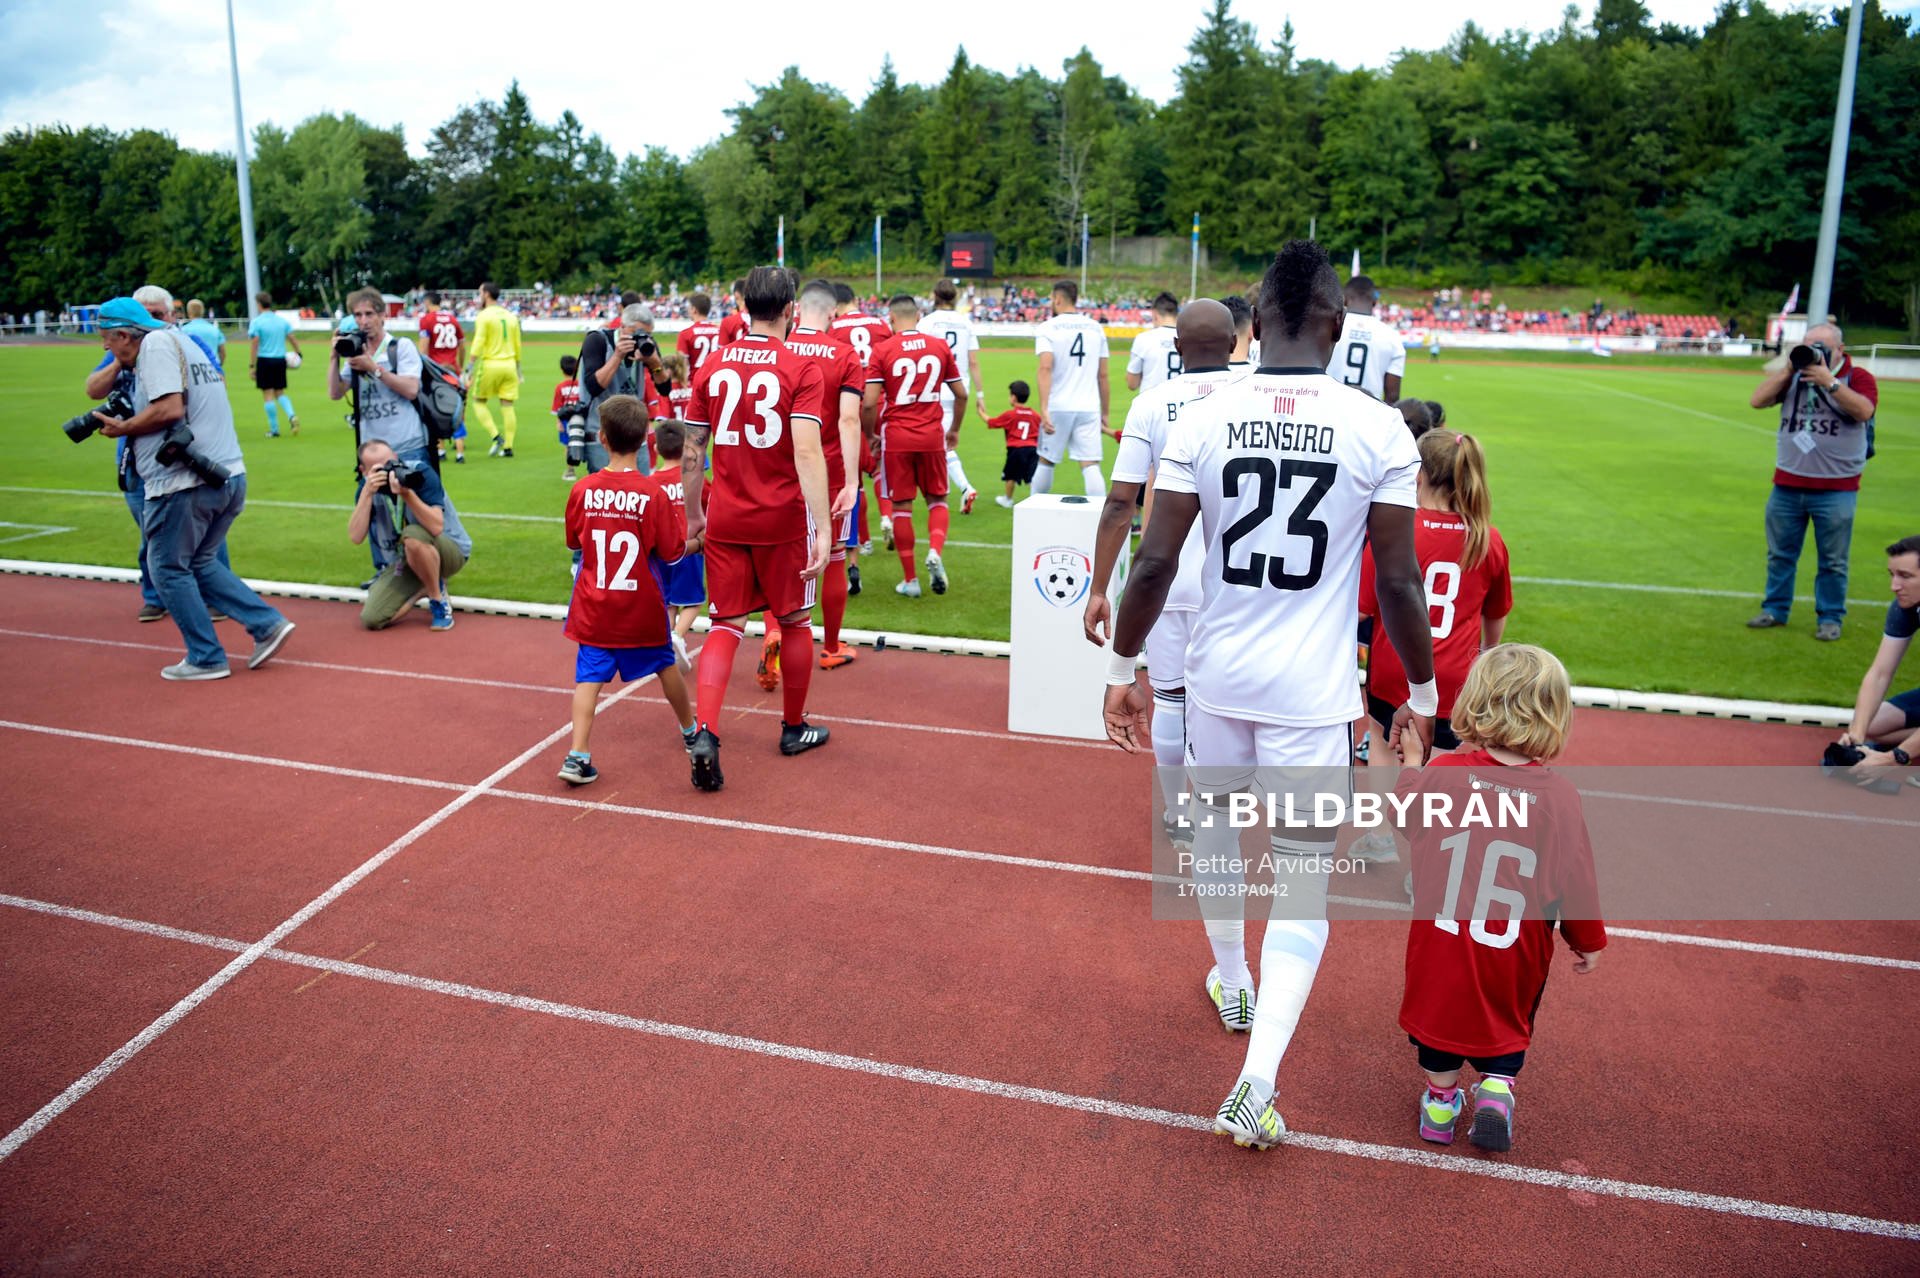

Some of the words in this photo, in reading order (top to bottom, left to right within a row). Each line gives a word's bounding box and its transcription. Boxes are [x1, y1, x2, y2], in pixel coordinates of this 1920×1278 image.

[433, 323, 458, 349] 28
[784, 342, 836, 359] ETKOVIC
[850, 327, 872, 367] 8
[901, 338, 926, 351] SAITI
[1069, 332, 1086, 367] 4
[721, 347, 777, 365] LATERZA
[1344, 342, 1368, 386] 9
[892, 355, 941, 405] 22
[1295, 389, 1319, 397] aldrig
[708, 368, 783, 449] 23
[1017, 421, 1030, 440] 7
[1226, 421, 1335, 455] MENSIRO
[584, 489, 650, 515] ASPORT
[1222, 457, 1338, 591] 23
[591, 529, 640, 591] 12
[1423, 561, 1461, 639] 8
[1434, 830, 1537, 949] 16
